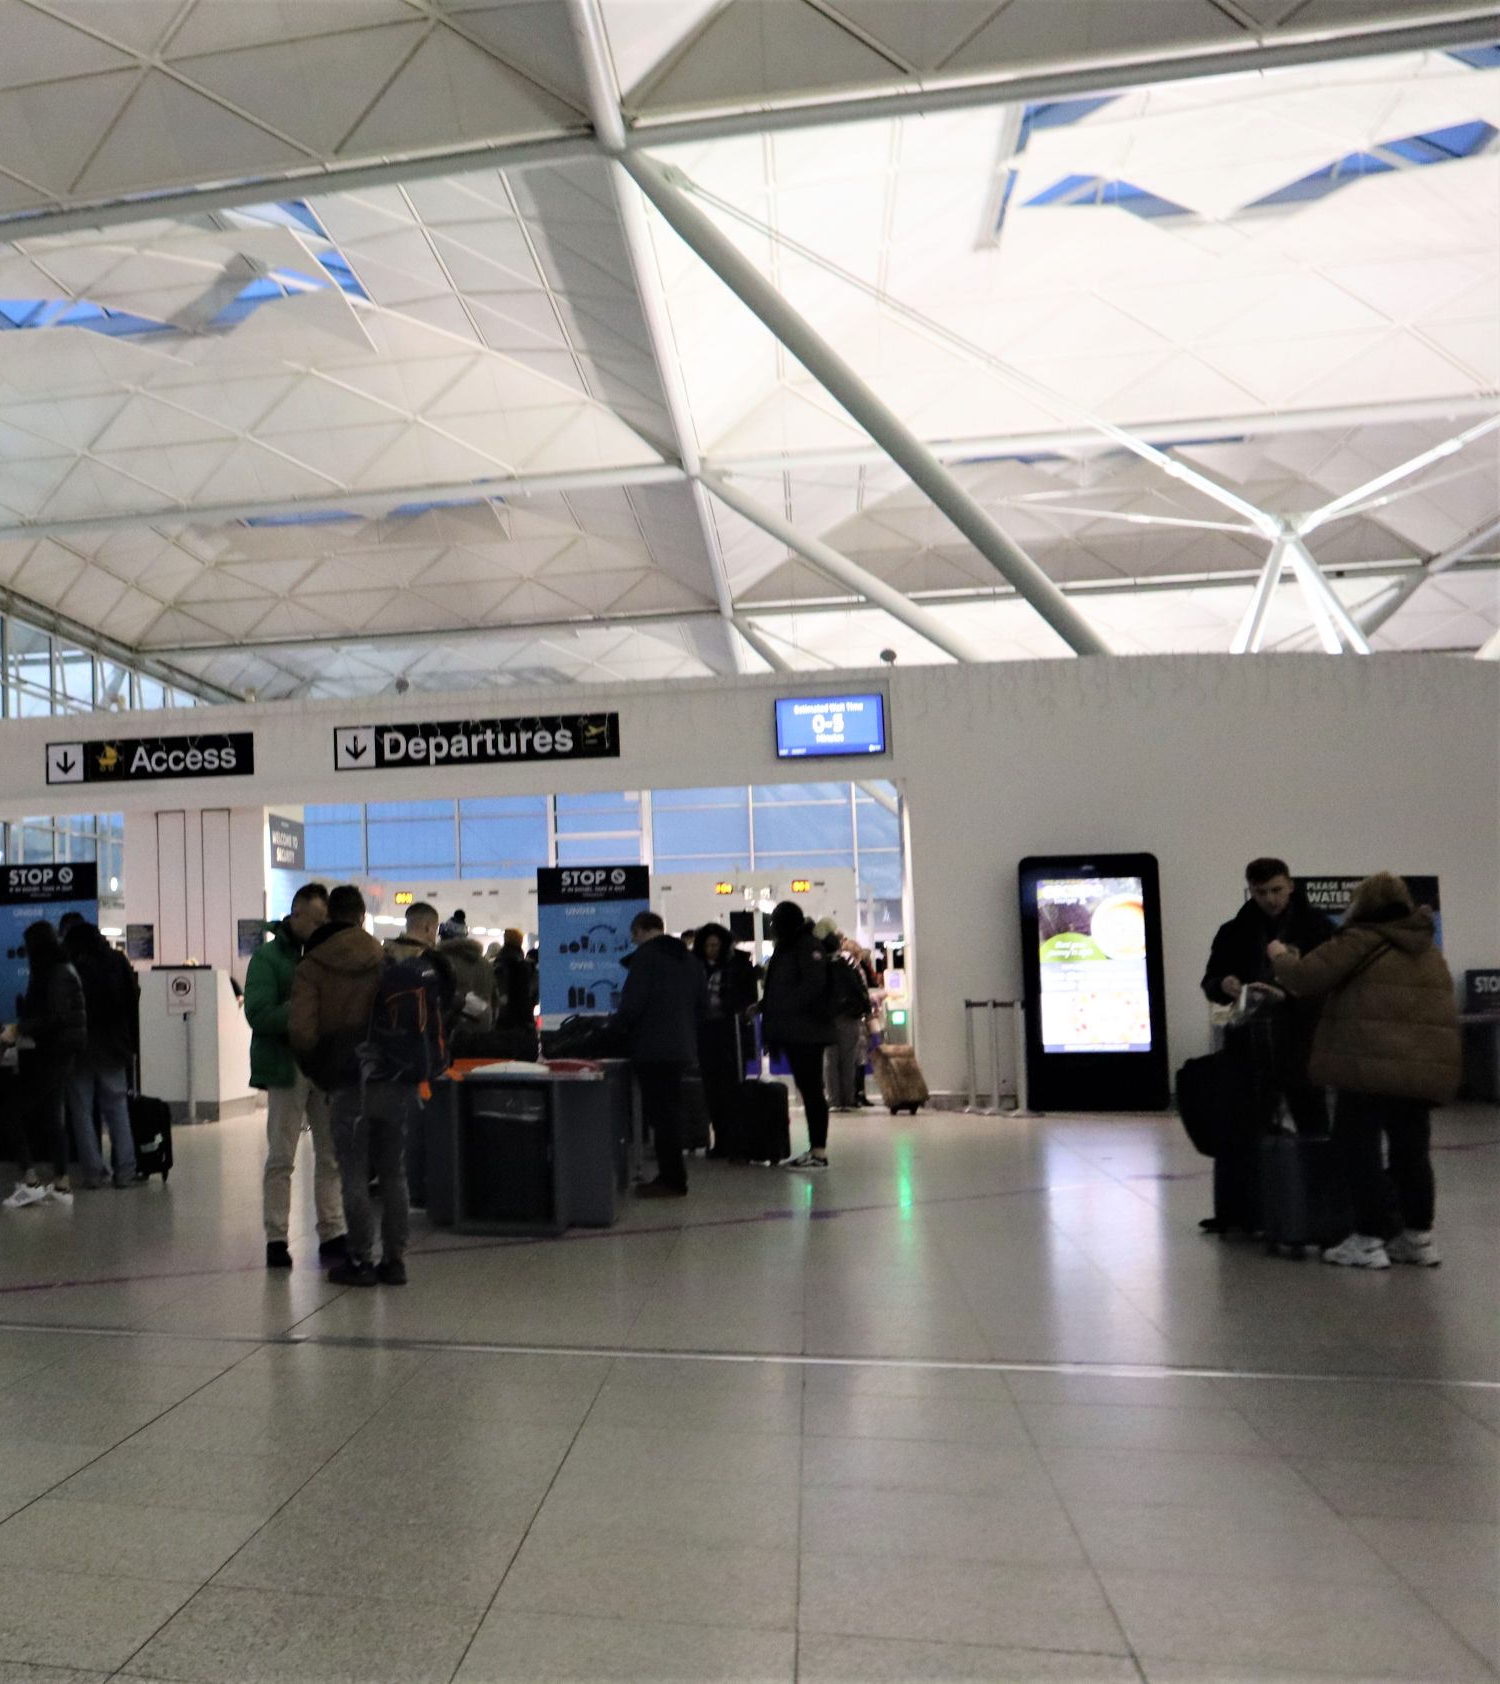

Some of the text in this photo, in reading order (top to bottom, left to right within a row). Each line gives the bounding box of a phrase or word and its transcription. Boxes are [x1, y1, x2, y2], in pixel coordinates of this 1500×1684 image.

[383, 728, 574, 766] Departures
[130, 746, 237, 773] Access
[9, 868, 54, 886] STOP
[561, 870, 606, 886] STOP
[1306, 880, 1339, 891] PLEASE
[1307, 890, 1351, 904] WATER
[1474, 975, 1500, 993] STO
